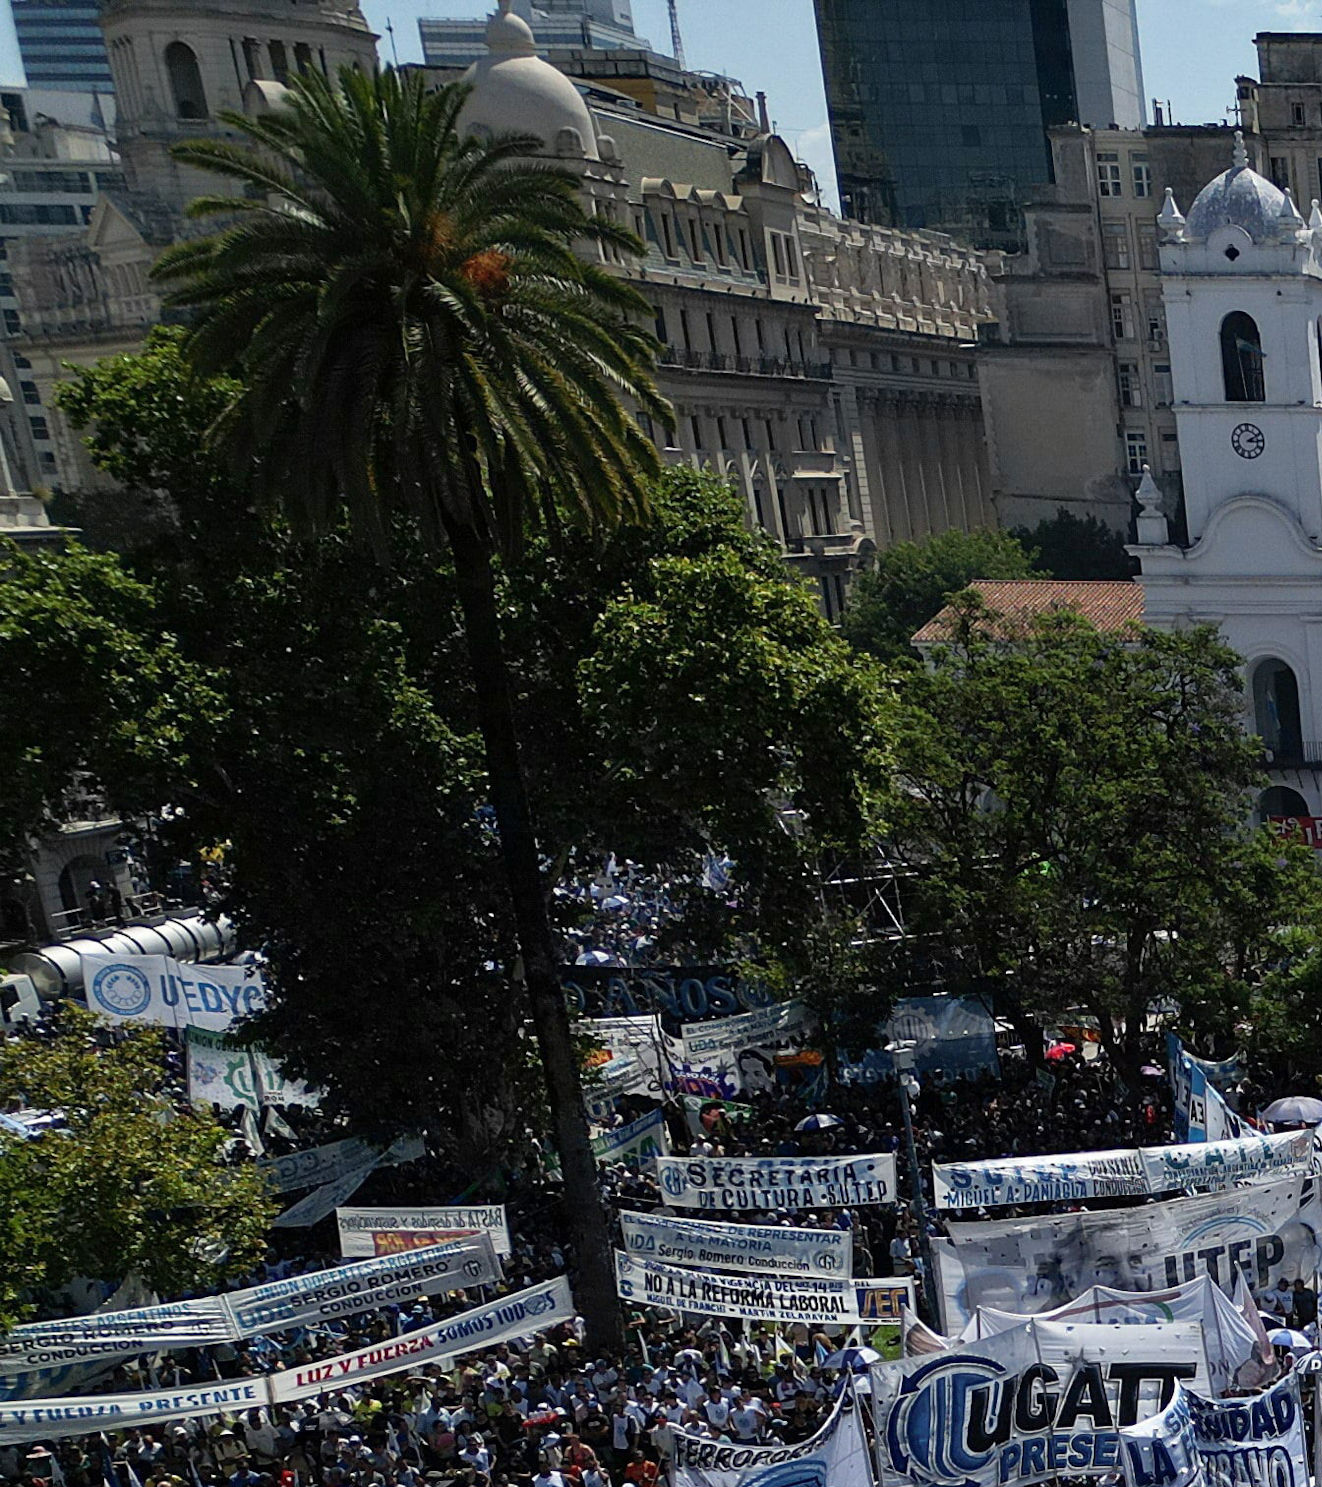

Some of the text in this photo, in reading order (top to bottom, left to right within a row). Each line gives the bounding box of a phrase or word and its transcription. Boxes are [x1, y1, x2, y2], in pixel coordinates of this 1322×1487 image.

[688, 1163, 856, 1189] SECRETARIA
[700, 1190, 716, 1209] DE
[722, 1188, 814, 1208] CULTURA
[749, 1228, 841, 1245] REPRESENTAR
[658, 1244, 694, 1260] Sergio
[699, 1248, 743, 1266] Romero
[292, 1262, 449, 1307] SERGIO ROMERO
[644, 1273, 849, 1313] NO A LA REFORMA LABORAL
[320, 1284, 422, 1315] CONDUCCION
[27, 1339, 143, 1364] CONDUCCION
[296, 1316, 494, 1386] LUZ Y FUERZA SOMOS
[139, 1386, 257, 1412] PRESENTE
[1000, 1431, 1120, 1483] PRESE
